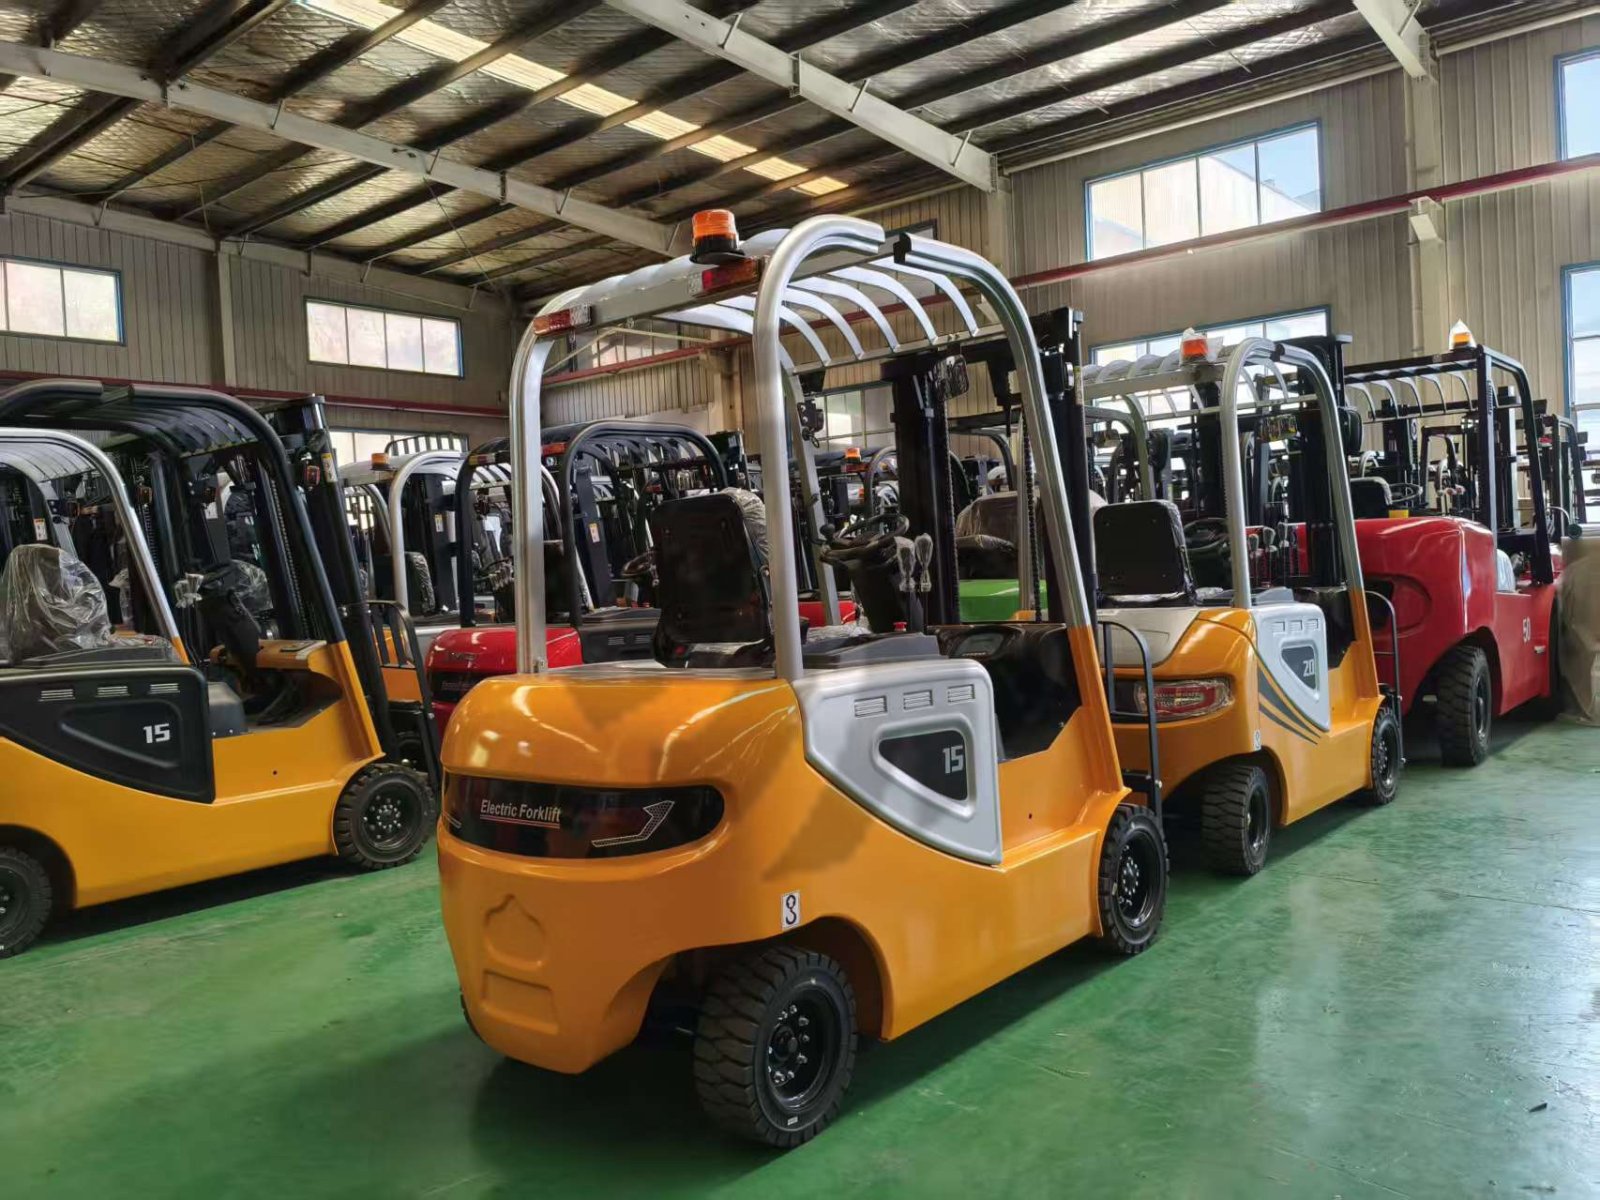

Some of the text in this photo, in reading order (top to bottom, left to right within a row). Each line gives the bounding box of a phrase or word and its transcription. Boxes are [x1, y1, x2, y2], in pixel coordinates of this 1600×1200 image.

[1303, 659, 1314, 677] 20
[143, 723, 170, 743] 15
[942, 745, 963, 773] 15
[480, 799, 561, 822] Electric Forklift
